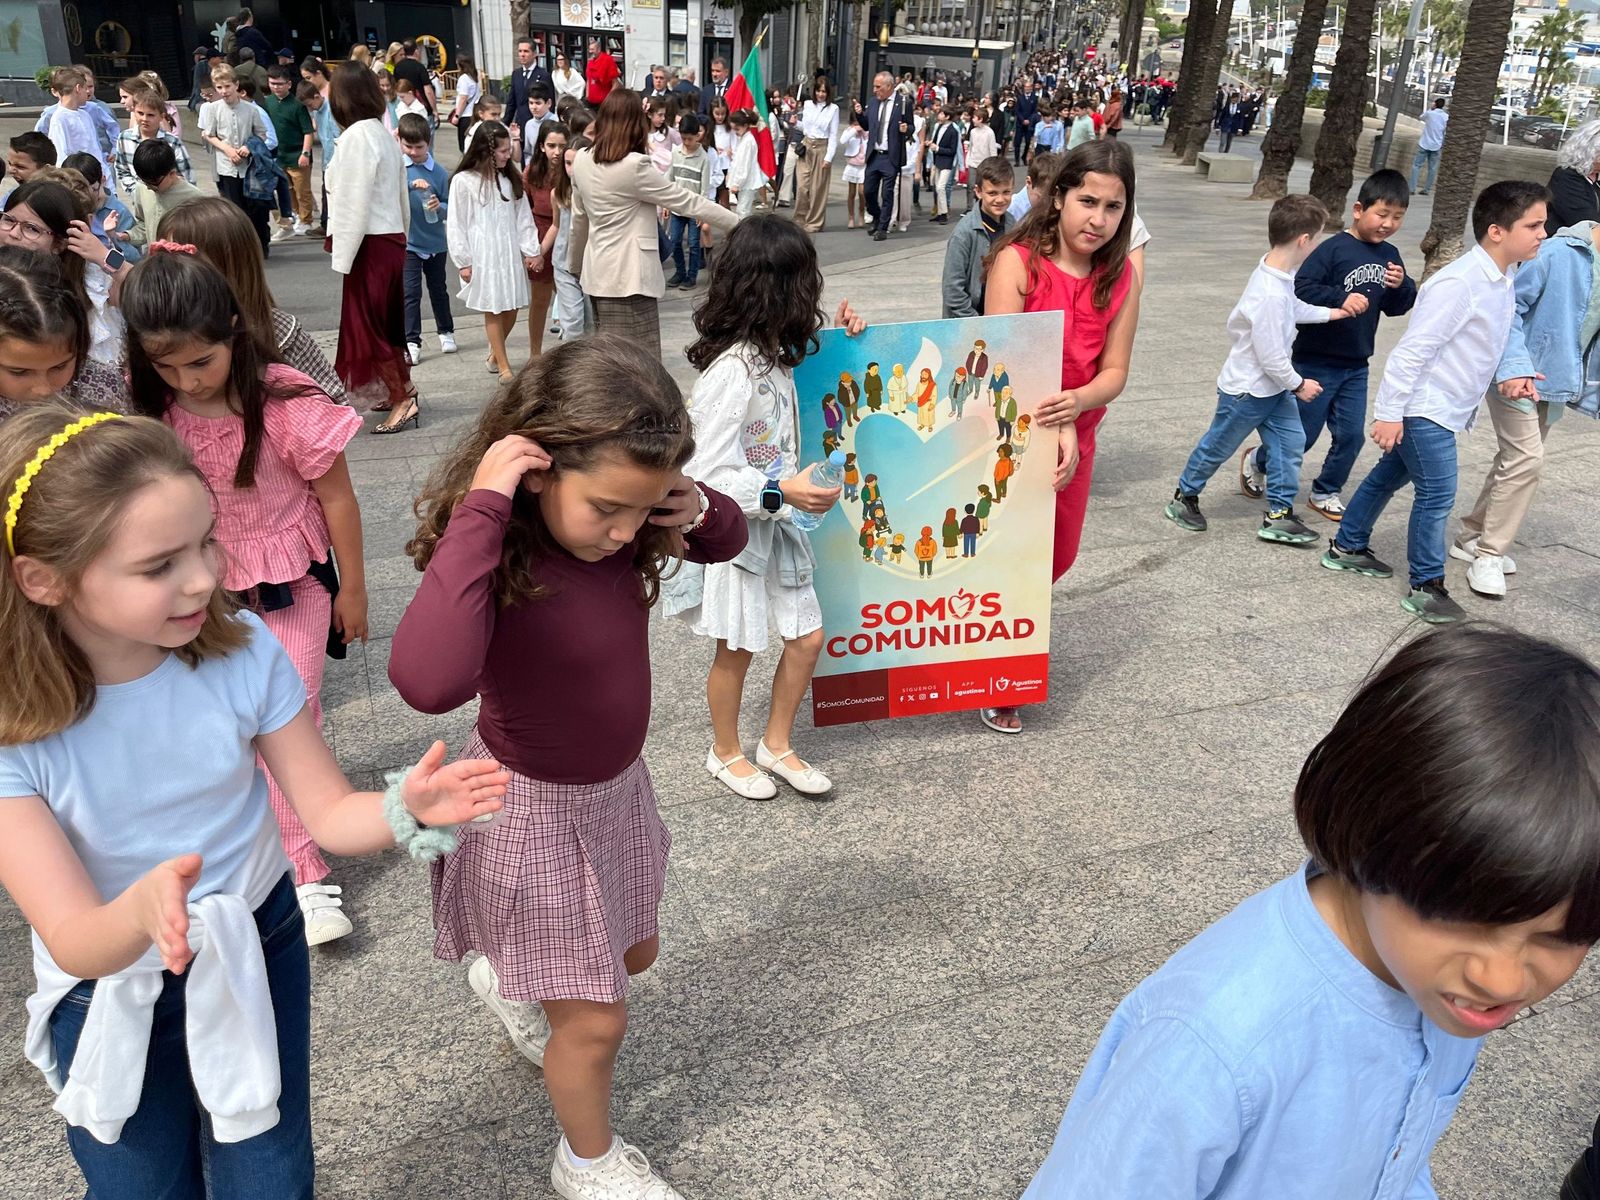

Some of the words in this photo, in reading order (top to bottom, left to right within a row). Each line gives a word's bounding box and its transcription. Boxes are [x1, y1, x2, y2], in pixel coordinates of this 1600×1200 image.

[1344, 263, 1387, 292] TOMM
[826, 617, 1035, 658] COMUNIDAD
[954, 688, 985, 696] agustinos
[1011, 679, 1042, 687] Agustinos
